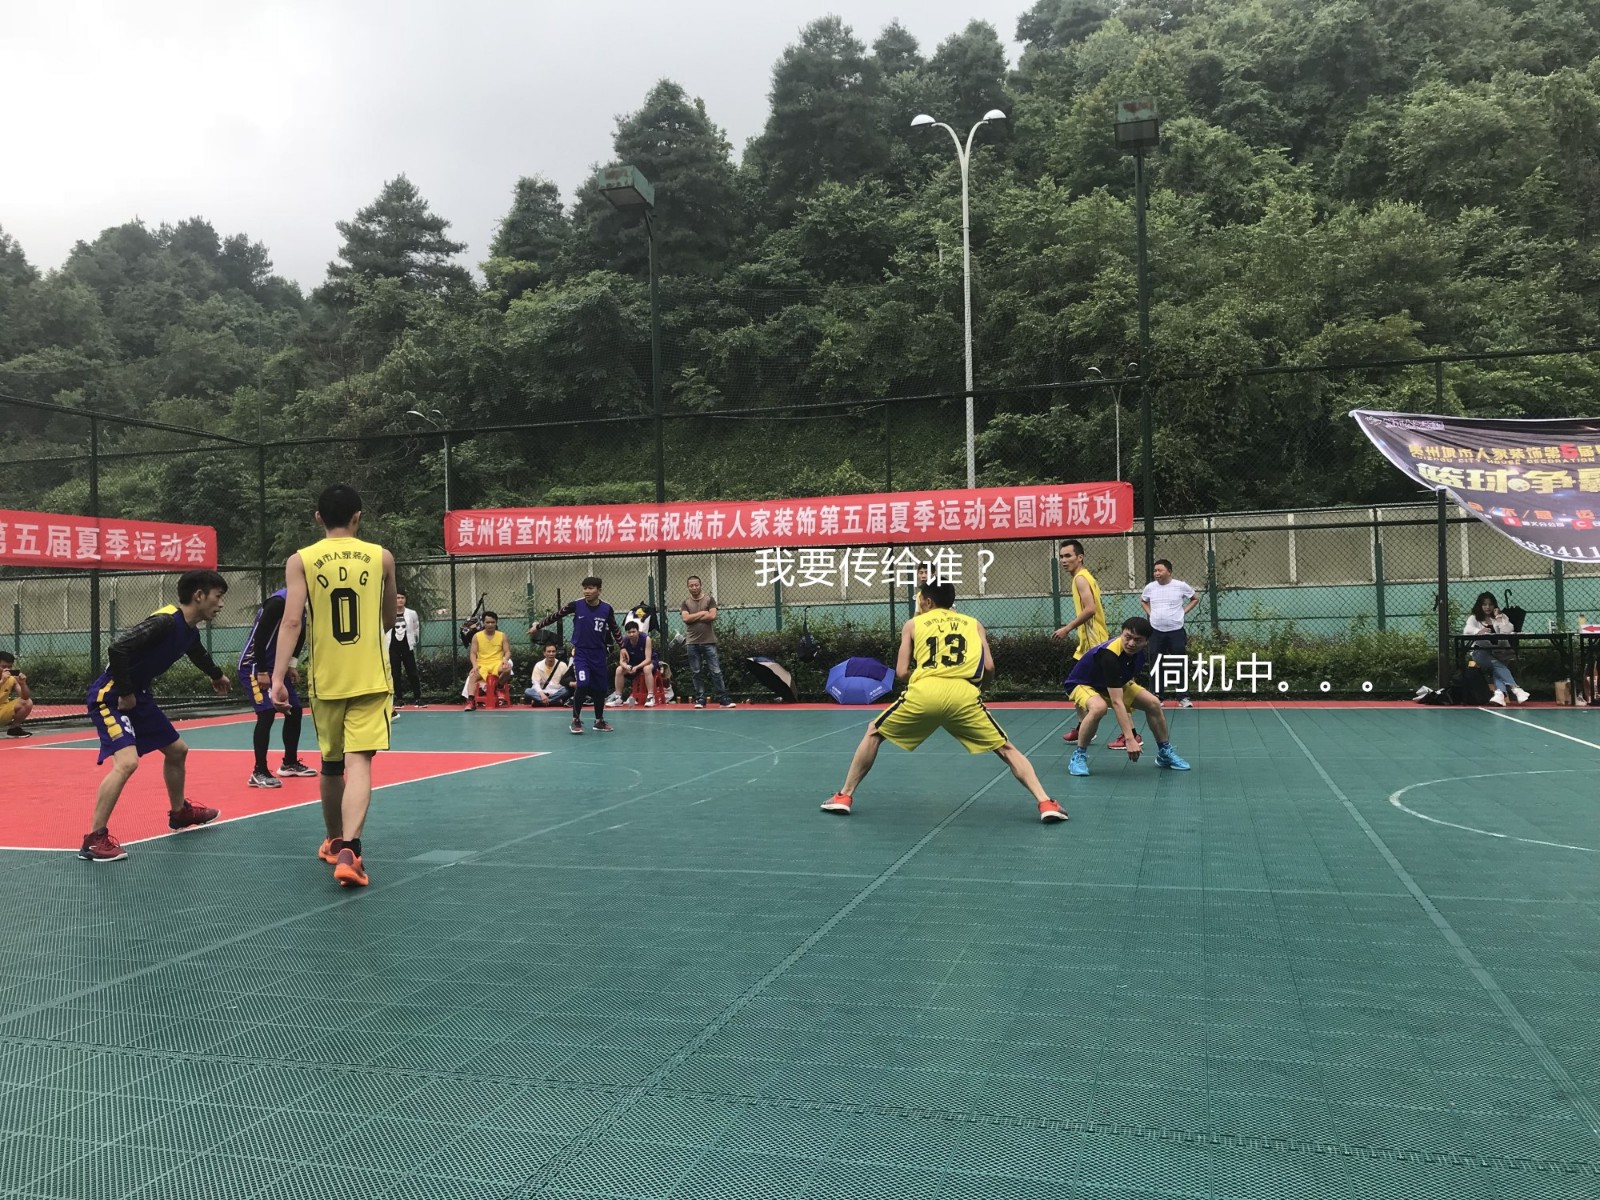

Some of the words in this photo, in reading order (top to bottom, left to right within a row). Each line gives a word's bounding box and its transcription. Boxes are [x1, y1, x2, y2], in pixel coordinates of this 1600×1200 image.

[458, 490, 1117, 547] 贵州省室内装饰协会预祝城市人家装饰第五届夏季运动会圆满成功
[330, 587, 361, 645] 0
[594, 620, 604, 632] 12
[922, 633, 967, 669] 13
